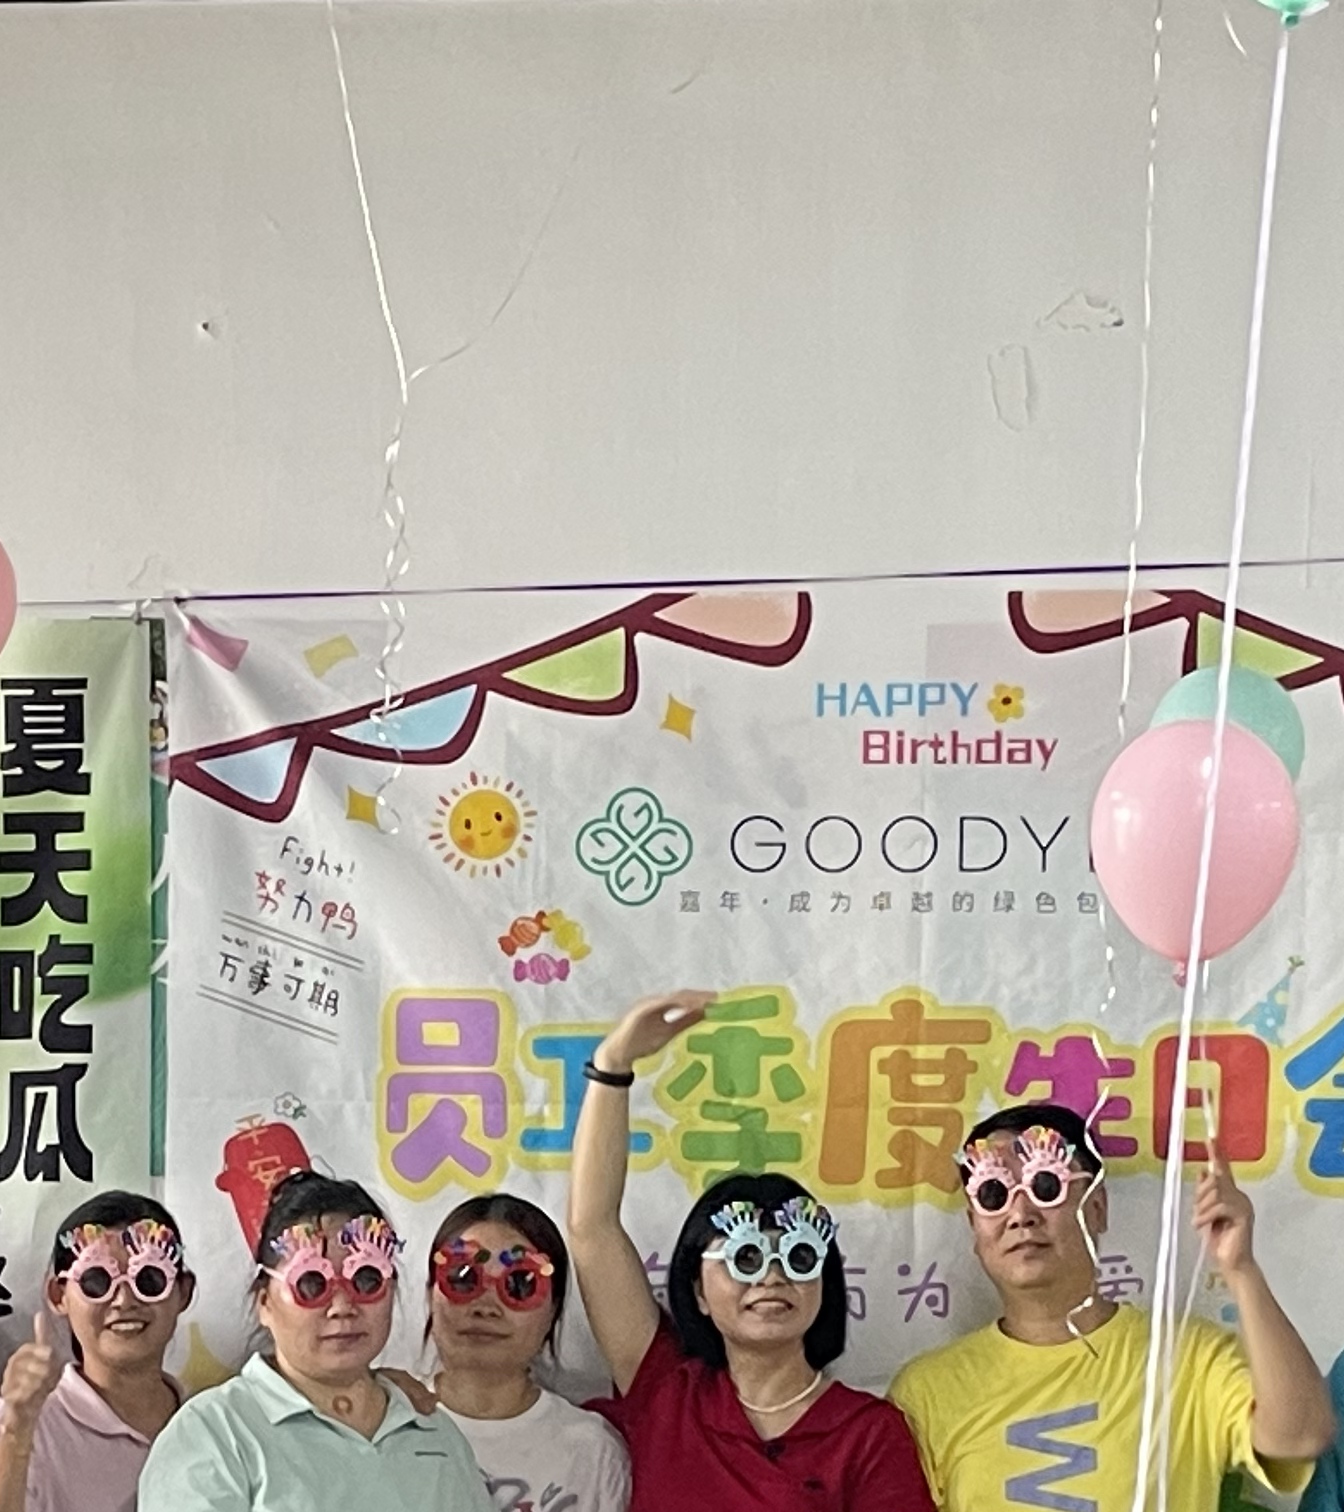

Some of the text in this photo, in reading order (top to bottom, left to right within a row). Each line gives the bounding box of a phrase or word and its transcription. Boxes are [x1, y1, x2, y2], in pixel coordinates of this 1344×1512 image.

[816, 682, 978, 717] HAPPY
[862, 729, 1058, 771] Birthday
[730, 814, 1096, 873] GOODY
[255, 870, 358, 940] 努力鸭
